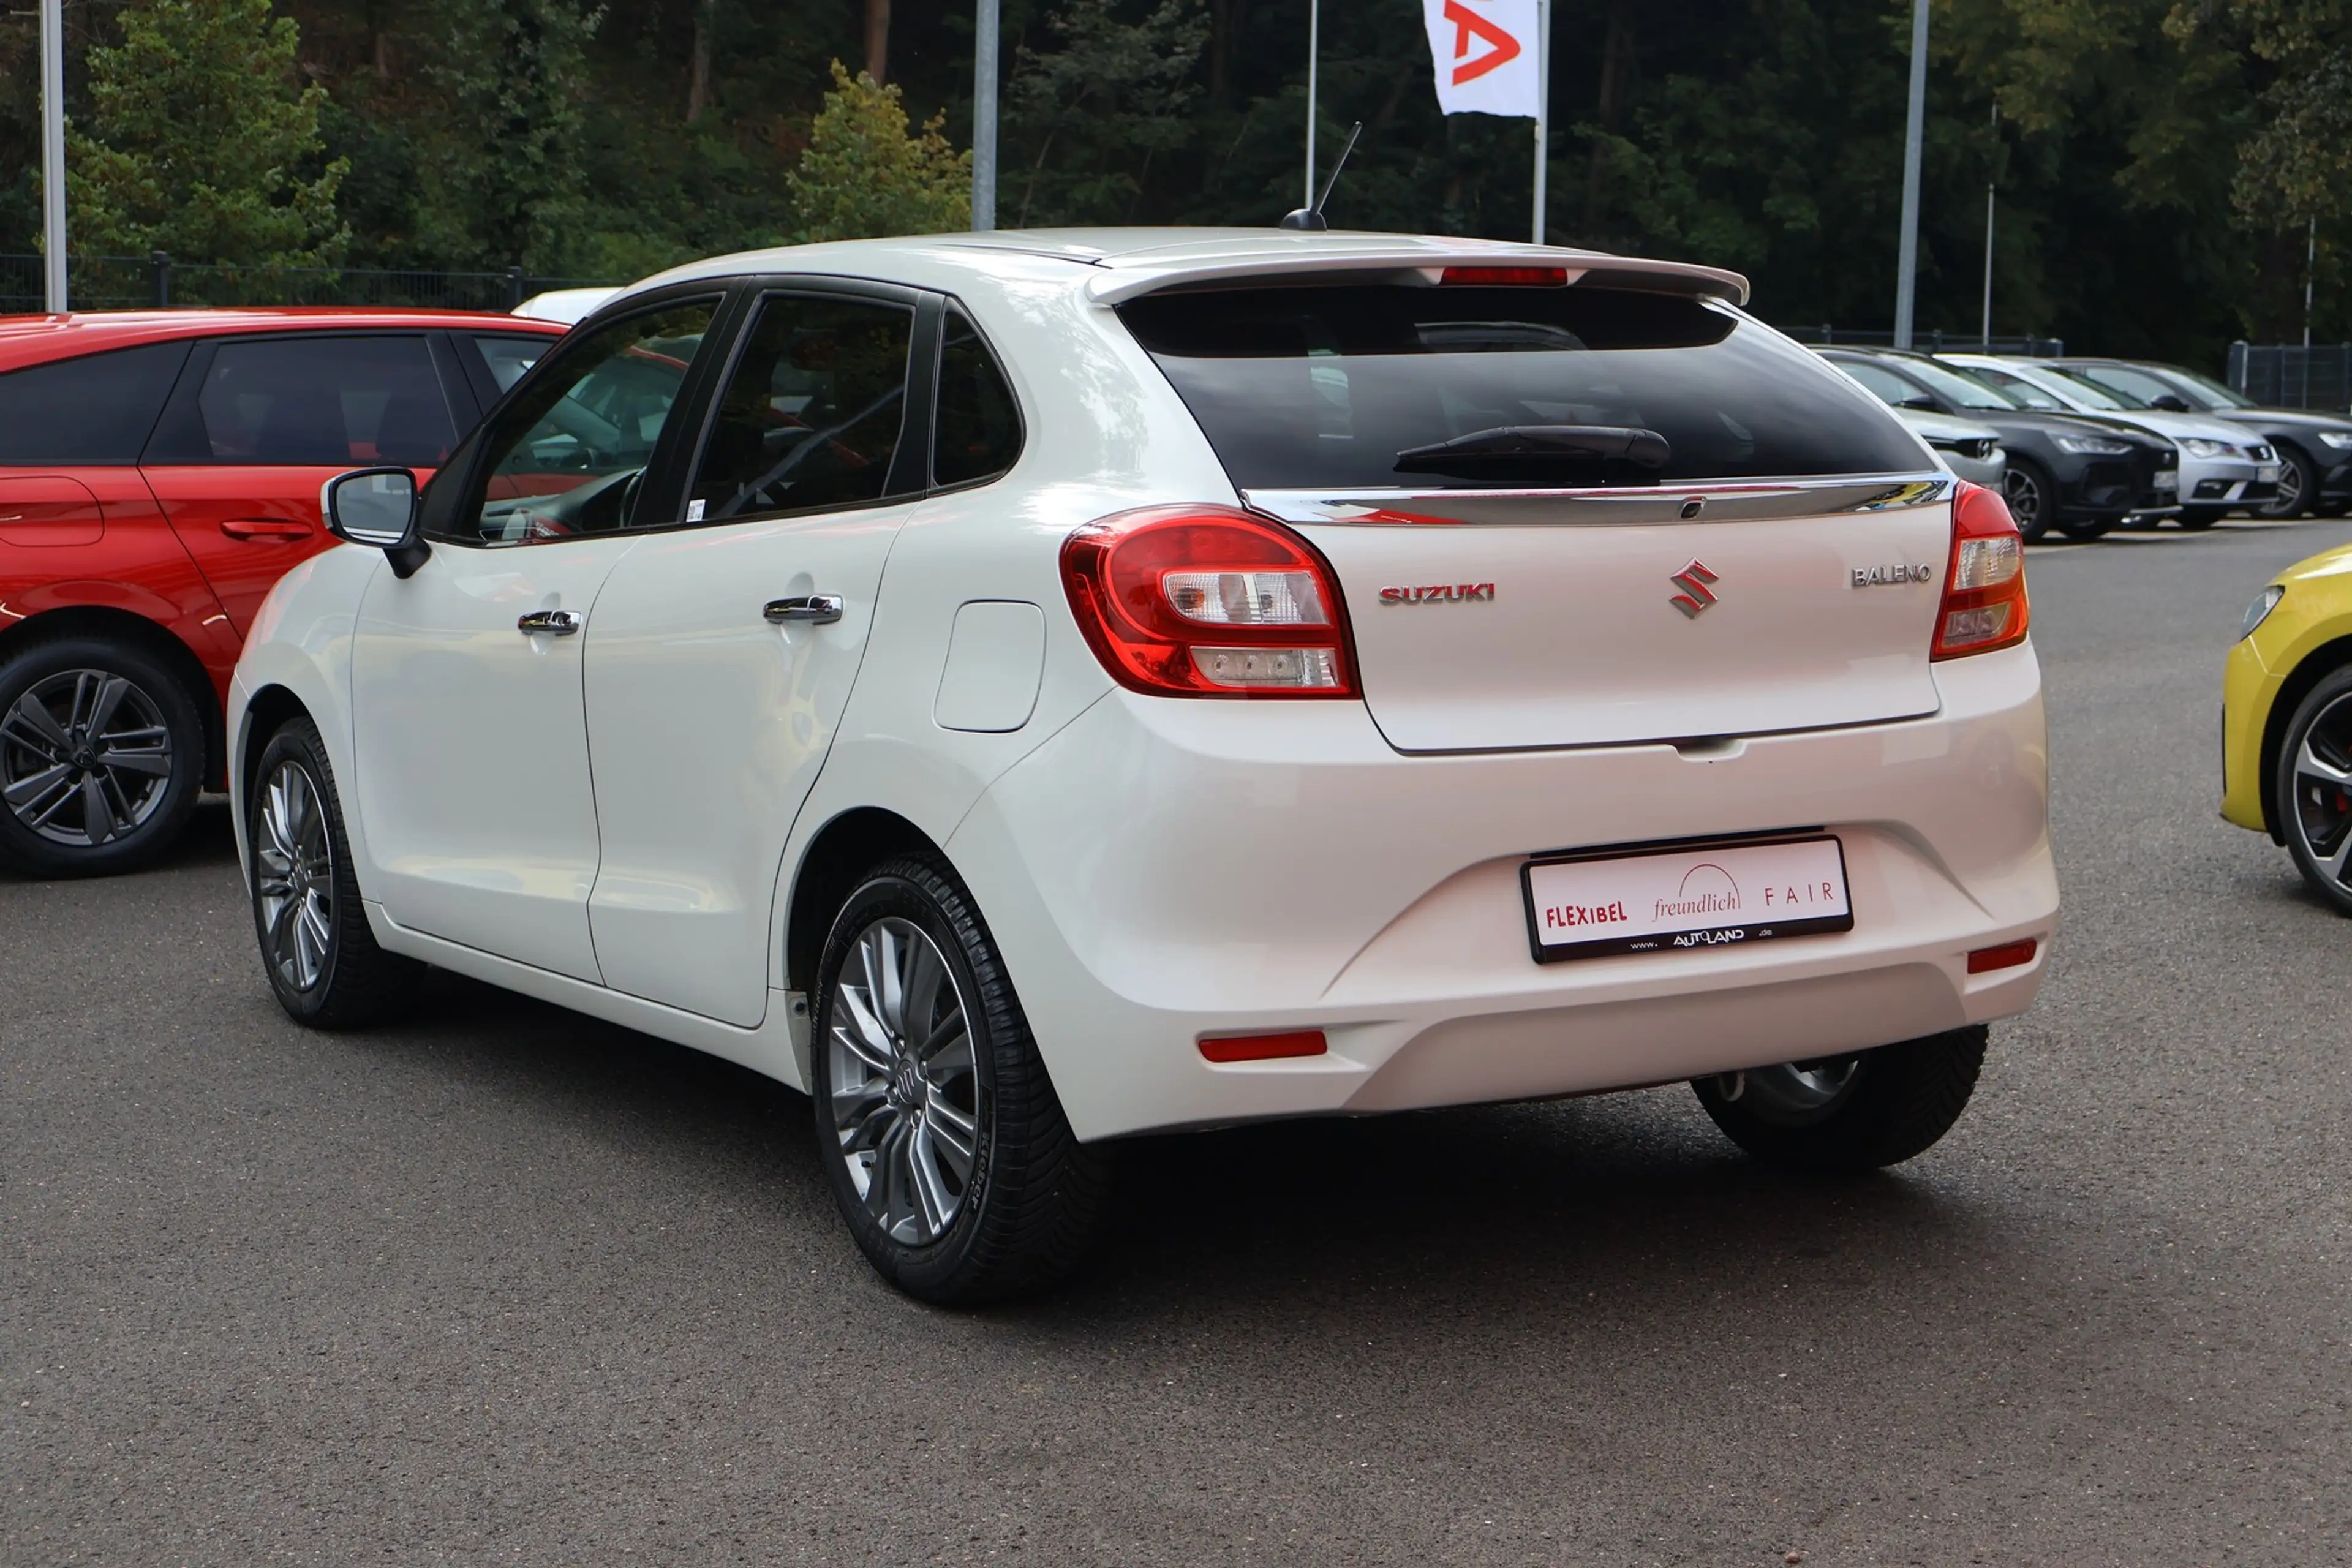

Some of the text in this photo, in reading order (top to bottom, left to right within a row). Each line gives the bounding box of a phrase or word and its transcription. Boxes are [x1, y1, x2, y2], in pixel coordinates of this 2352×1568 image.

[1852, 564, 1931, 587] BALENO
[1379, 583, 1494, 606] SUZUKI
[1546, 900, 1627, 929] FLEXIBEL
[1652, 892, 1736, 922] freundlich
[1673, 929, 1744, 947] AUTOLAND
